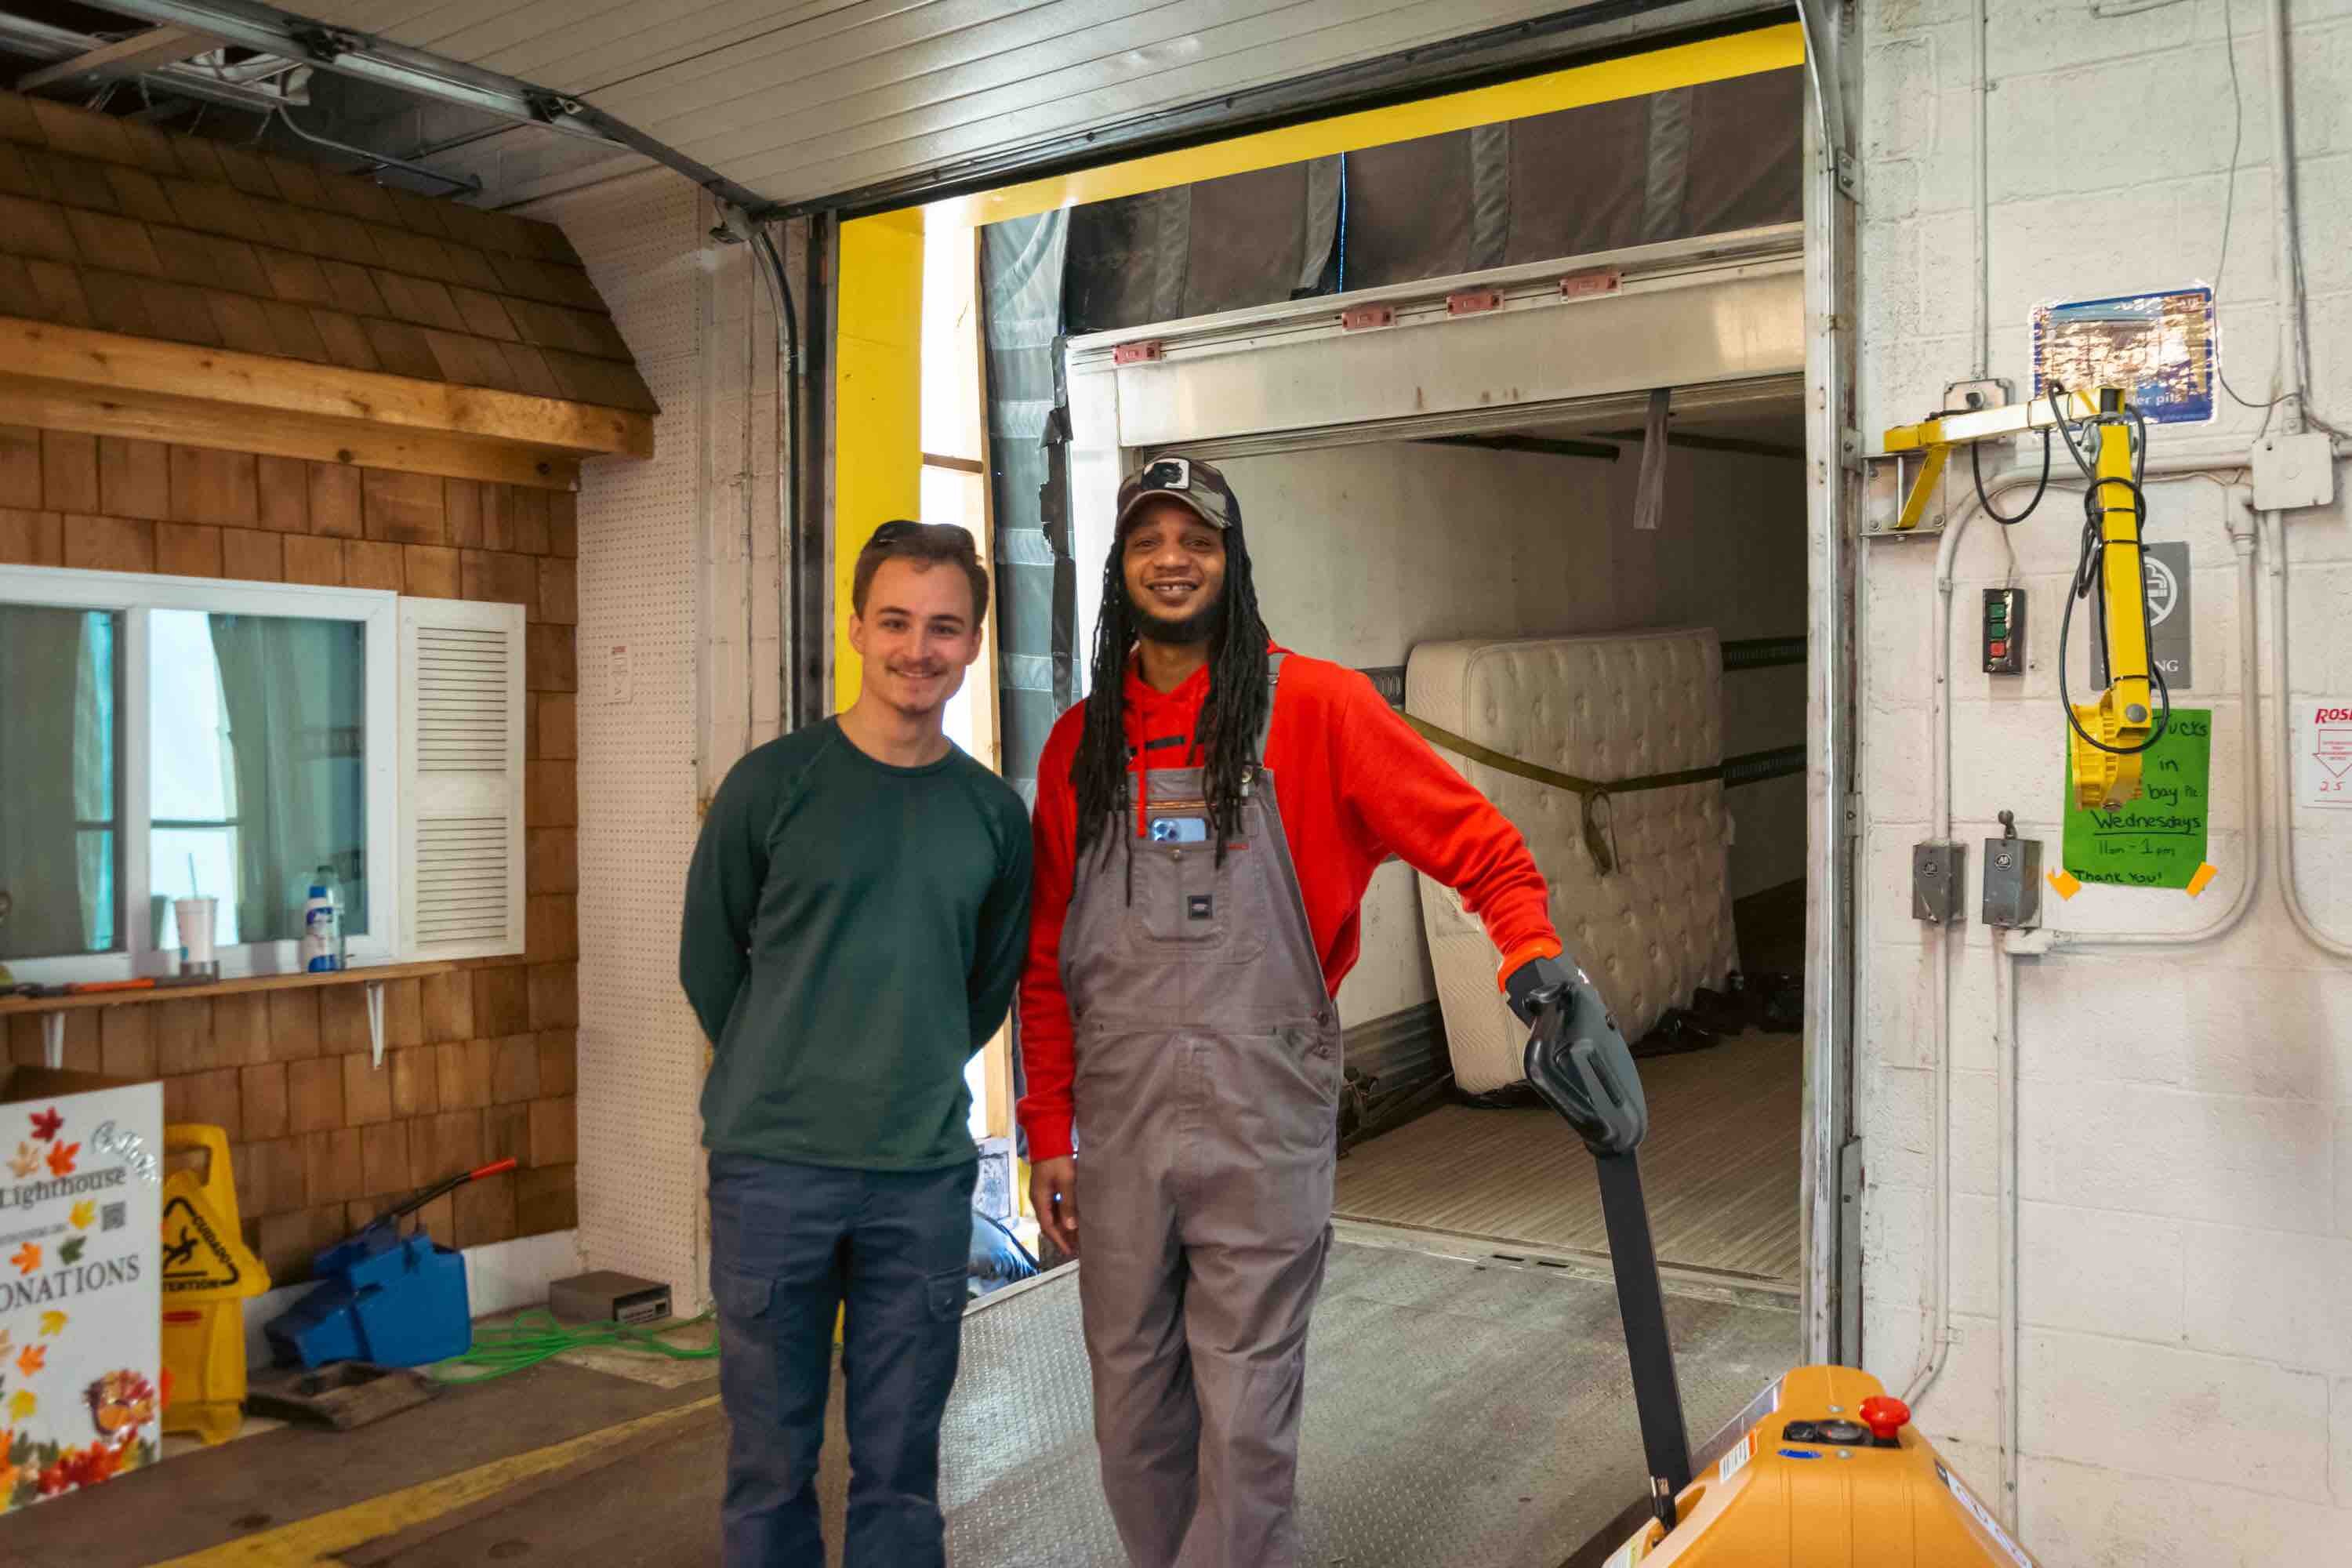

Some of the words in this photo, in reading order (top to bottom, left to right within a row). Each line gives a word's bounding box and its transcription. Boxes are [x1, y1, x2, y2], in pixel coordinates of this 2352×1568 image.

[2158, 755, 2179, 772] in
[2147, 784, 2177, 806] bay
[2072, 868, 2123, 884] Thank
[0, 1165, 125, 1210] Lighthouse
